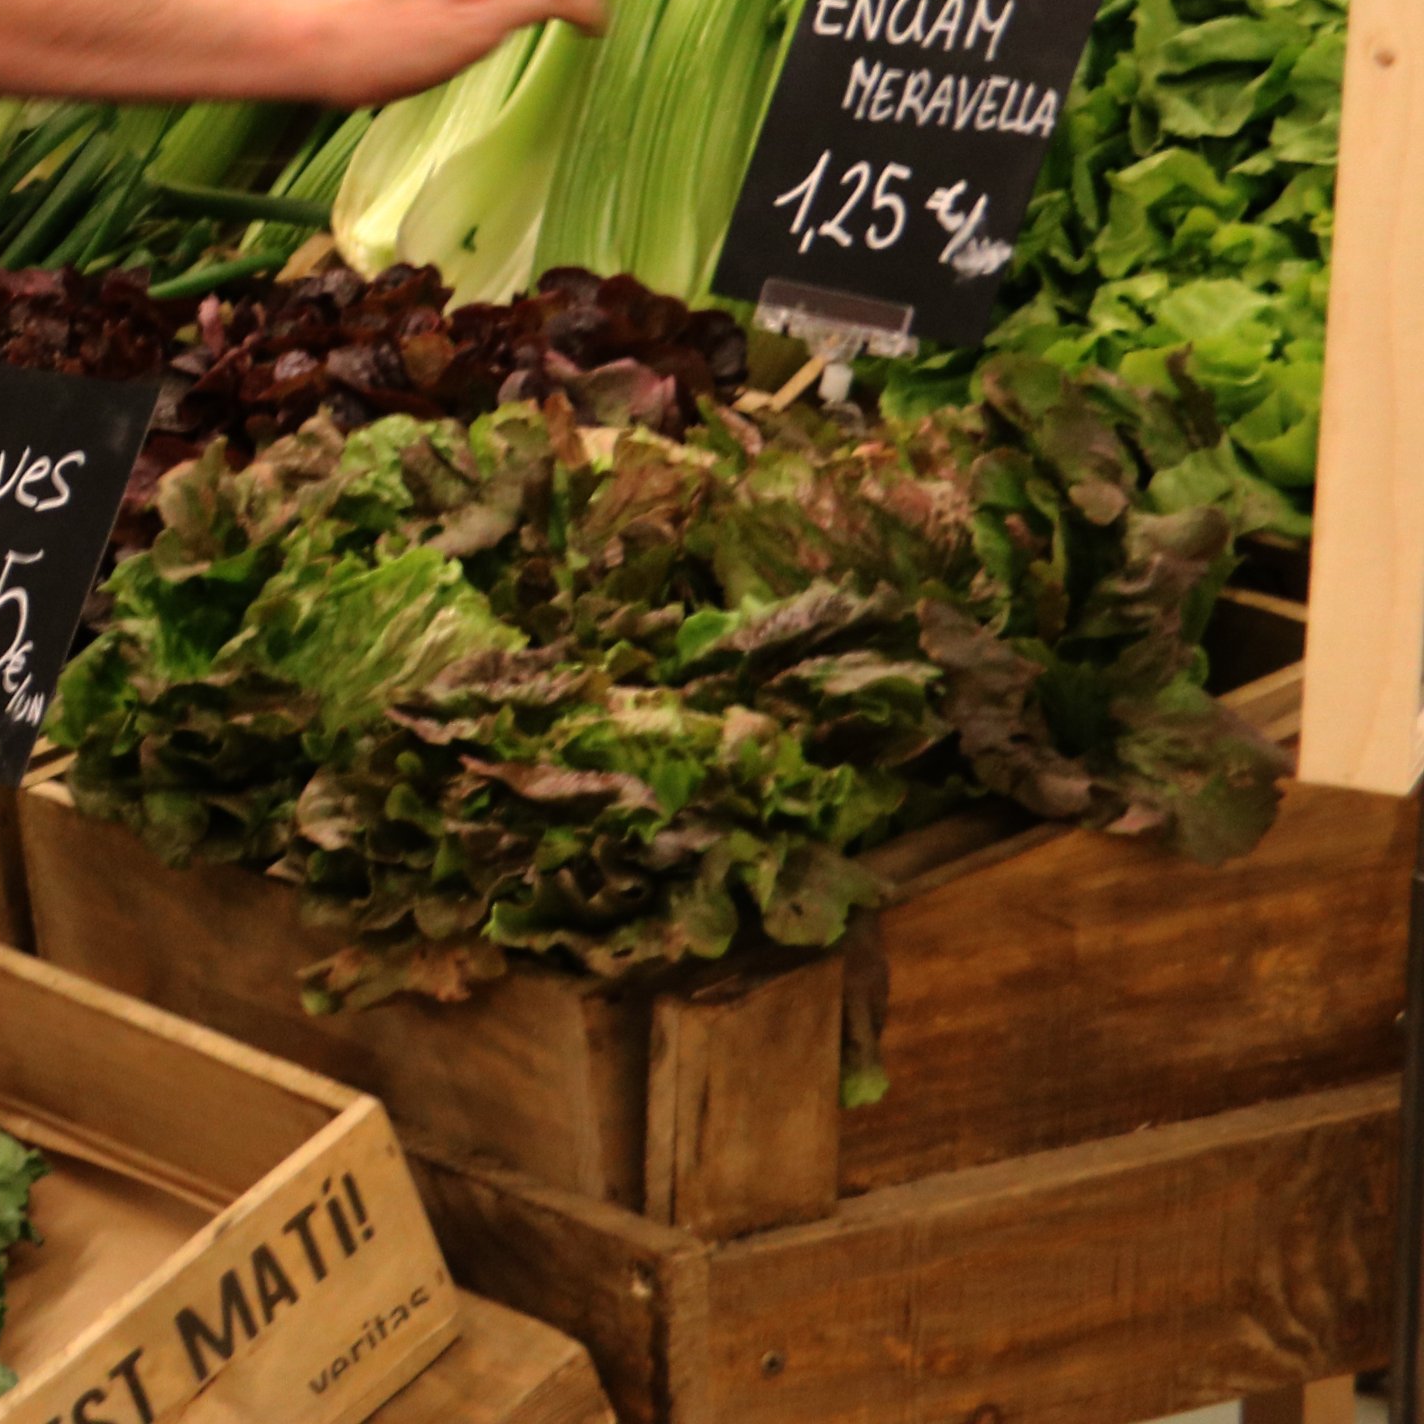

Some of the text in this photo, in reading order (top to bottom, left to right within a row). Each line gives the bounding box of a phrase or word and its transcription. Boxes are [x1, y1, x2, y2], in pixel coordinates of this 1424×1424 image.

[842, 57, 1060, 139] MERAVELLA
[773, 148, 912, 254] 1,25
[309, 1288, 431, 1396] veritas
